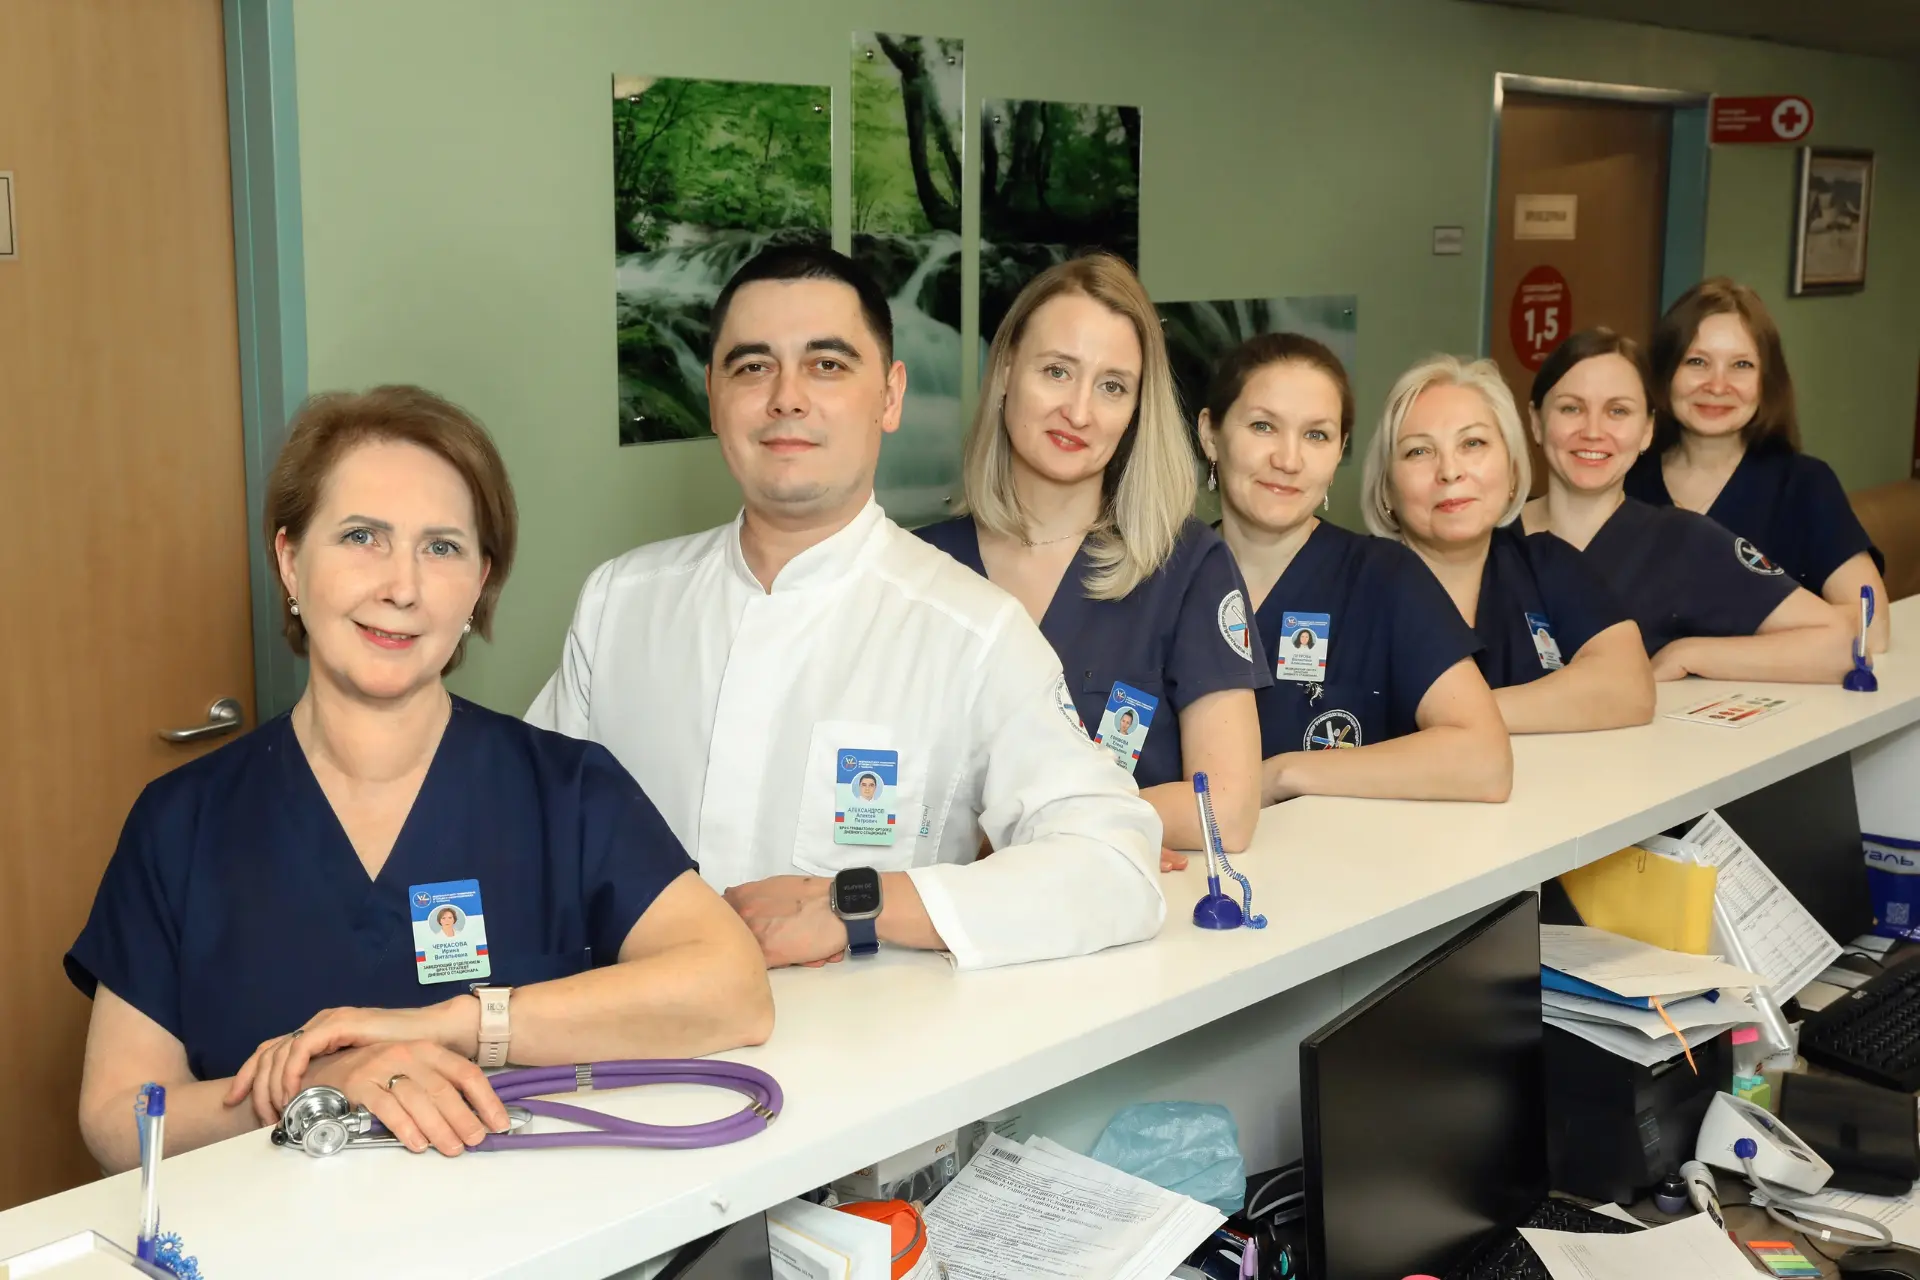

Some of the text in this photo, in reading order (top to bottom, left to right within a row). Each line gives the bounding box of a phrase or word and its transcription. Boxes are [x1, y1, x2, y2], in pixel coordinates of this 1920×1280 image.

[1524, 307, 1559, 350] 1,5
[432, 941, 468, 950] ЧЕРКАСОВА
[434, 953, 468, 961] Витальевна
